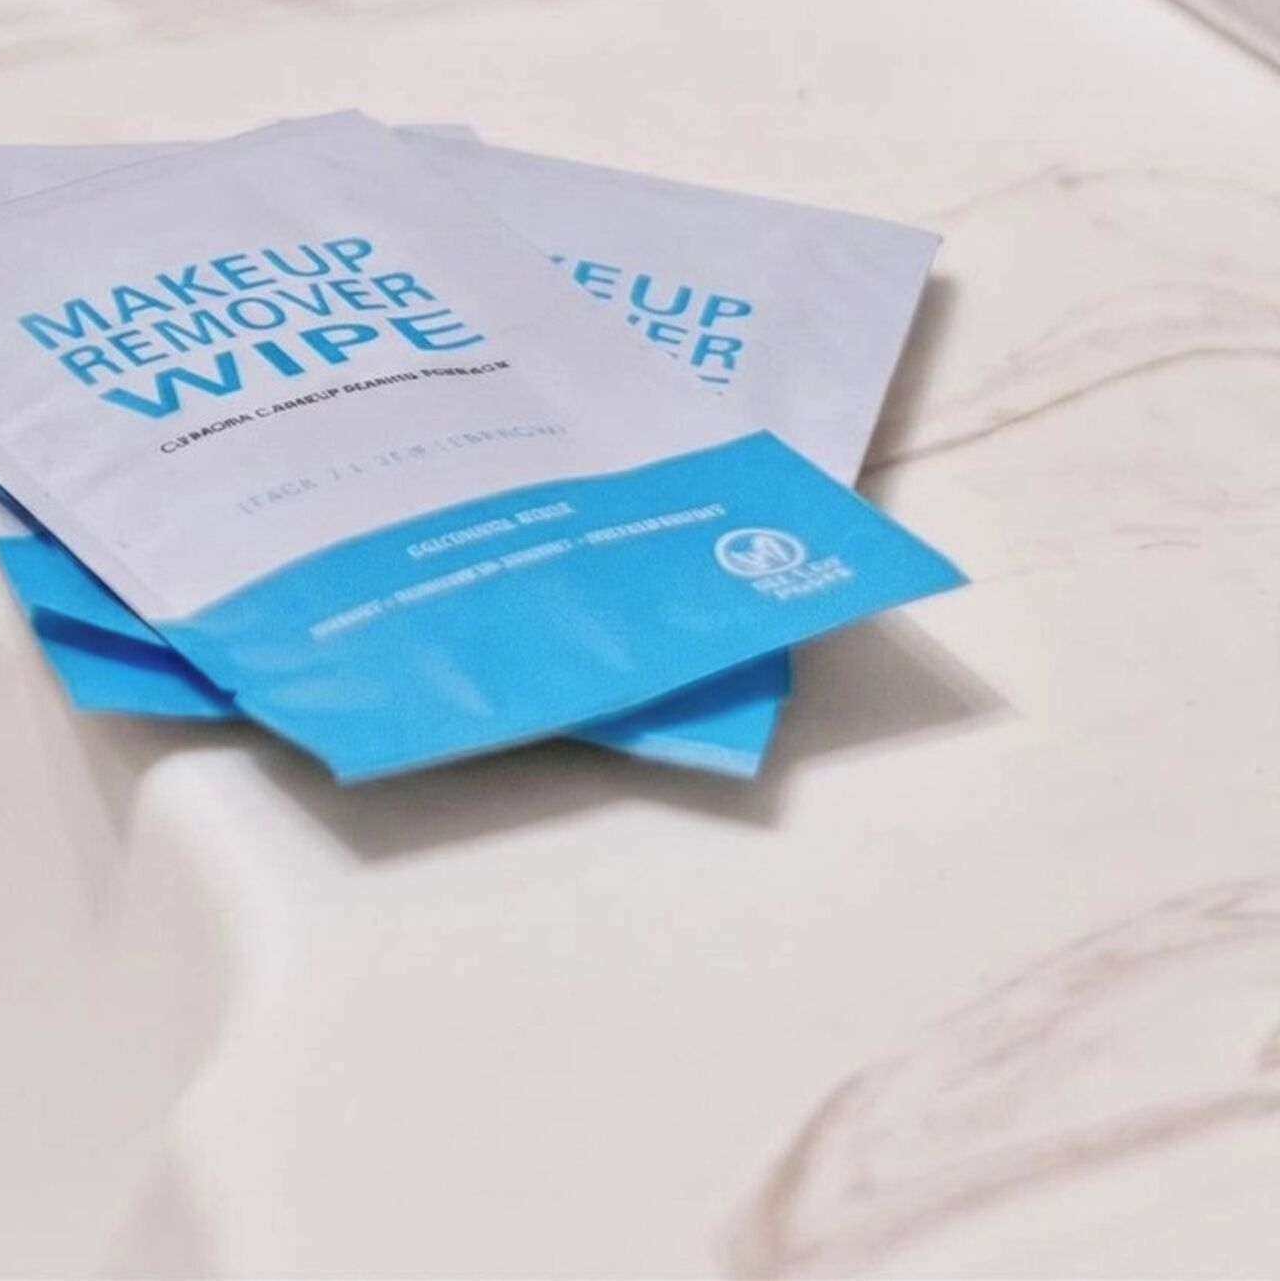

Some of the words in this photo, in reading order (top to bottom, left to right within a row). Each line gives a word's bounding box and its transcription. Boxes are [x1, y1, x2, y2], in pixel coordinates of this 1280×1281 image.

[18, 235, 376, 351] MAKEUP
[56, 270, 437, 387] REMOVER
[548, 254, 753, 328] EUP
[626, 313, 744, 371] ER
[98, 308, 487, 420] WIPE
